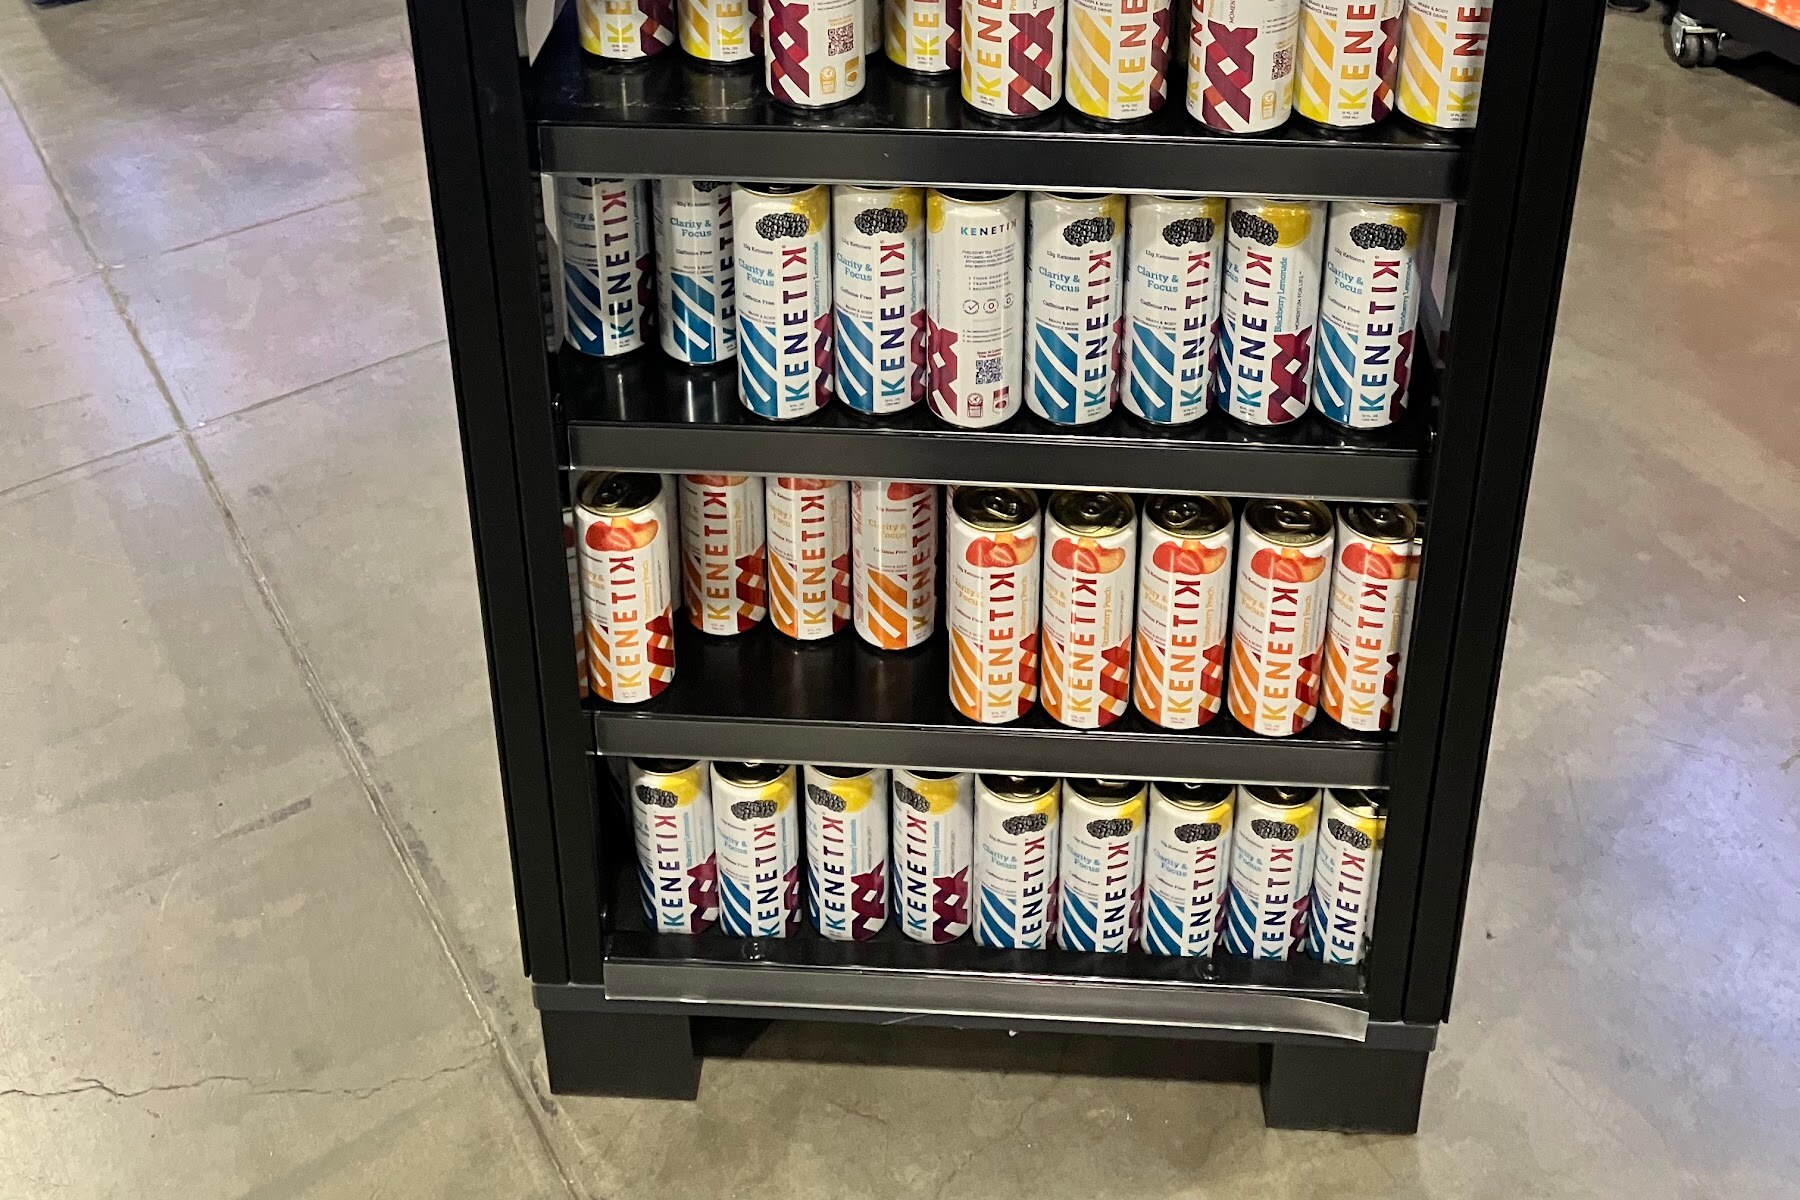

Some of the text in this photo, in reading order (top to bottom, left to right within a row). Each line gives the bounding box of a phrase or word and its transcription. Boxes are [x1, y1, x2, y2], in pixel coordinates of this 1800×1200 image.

[602, 191, 635, 340] KENETIK
[670, 217, 712, 230] Clarity &
[681, 228, 712, 238] Focus
[747, 272, 775, 287] Focus
[767, 269, 775, 277] &
[836, 253, 872, 271] Clarity &
[845, 267, 872, 281] Focus
[1039, 266, 1080, 283] Clarity &
[1137, 265, 1179, 283] Clarity &
[782, 246, 810, 403] KENETIK
[880, 242, 905, 397] KENETIK
[1049, 280, 1080, 293] Focus
[1084, 250, 1112, 408] KENETIK
[1147, 279, 1179, 293] Focus
[1180, 250, 1211, 408] KENETIK
[1236, 250, 1273, 408] KENETIK
[1274, 256, 1288, 333] Blackberry Lemonade
[1334, 278, 1363, 295] Focus
[1356, 276, 1364, 286] &
[1359, 260, 1400, 412] KENETIK
[703, 491, 730, 620] KENETIK
[801, 495, 827, 625] KENETIK
[609, 556, 641, 688] KENETIK
[988, 572, 1015, 708] KENETIK
[1067, 578, 1097, 712] KENETIK
[1168, 580, 1200, 713] KENETIK
[1262, 587, 1298, 721] KENETIK
[1349, 582, 1388, 715] KENETIK
[654, 815, 684, 927] KENETIK
[754, 824, 780, 937] KENETIK
[822, 816, 845, 931] KENETIK
[907, 815, 926, 931] KENETIK
[1022, 836, 1045, 948] KENETIK
[1103, 842, 1129, 953] KENETIK
[1161, 862, 1187, 877] Focus
[1188, 847, 1217, 957] KENETIK
[1261, 848, 1293, 961] KENETIK
[1330, 851, 1366, 965] KENETIK
